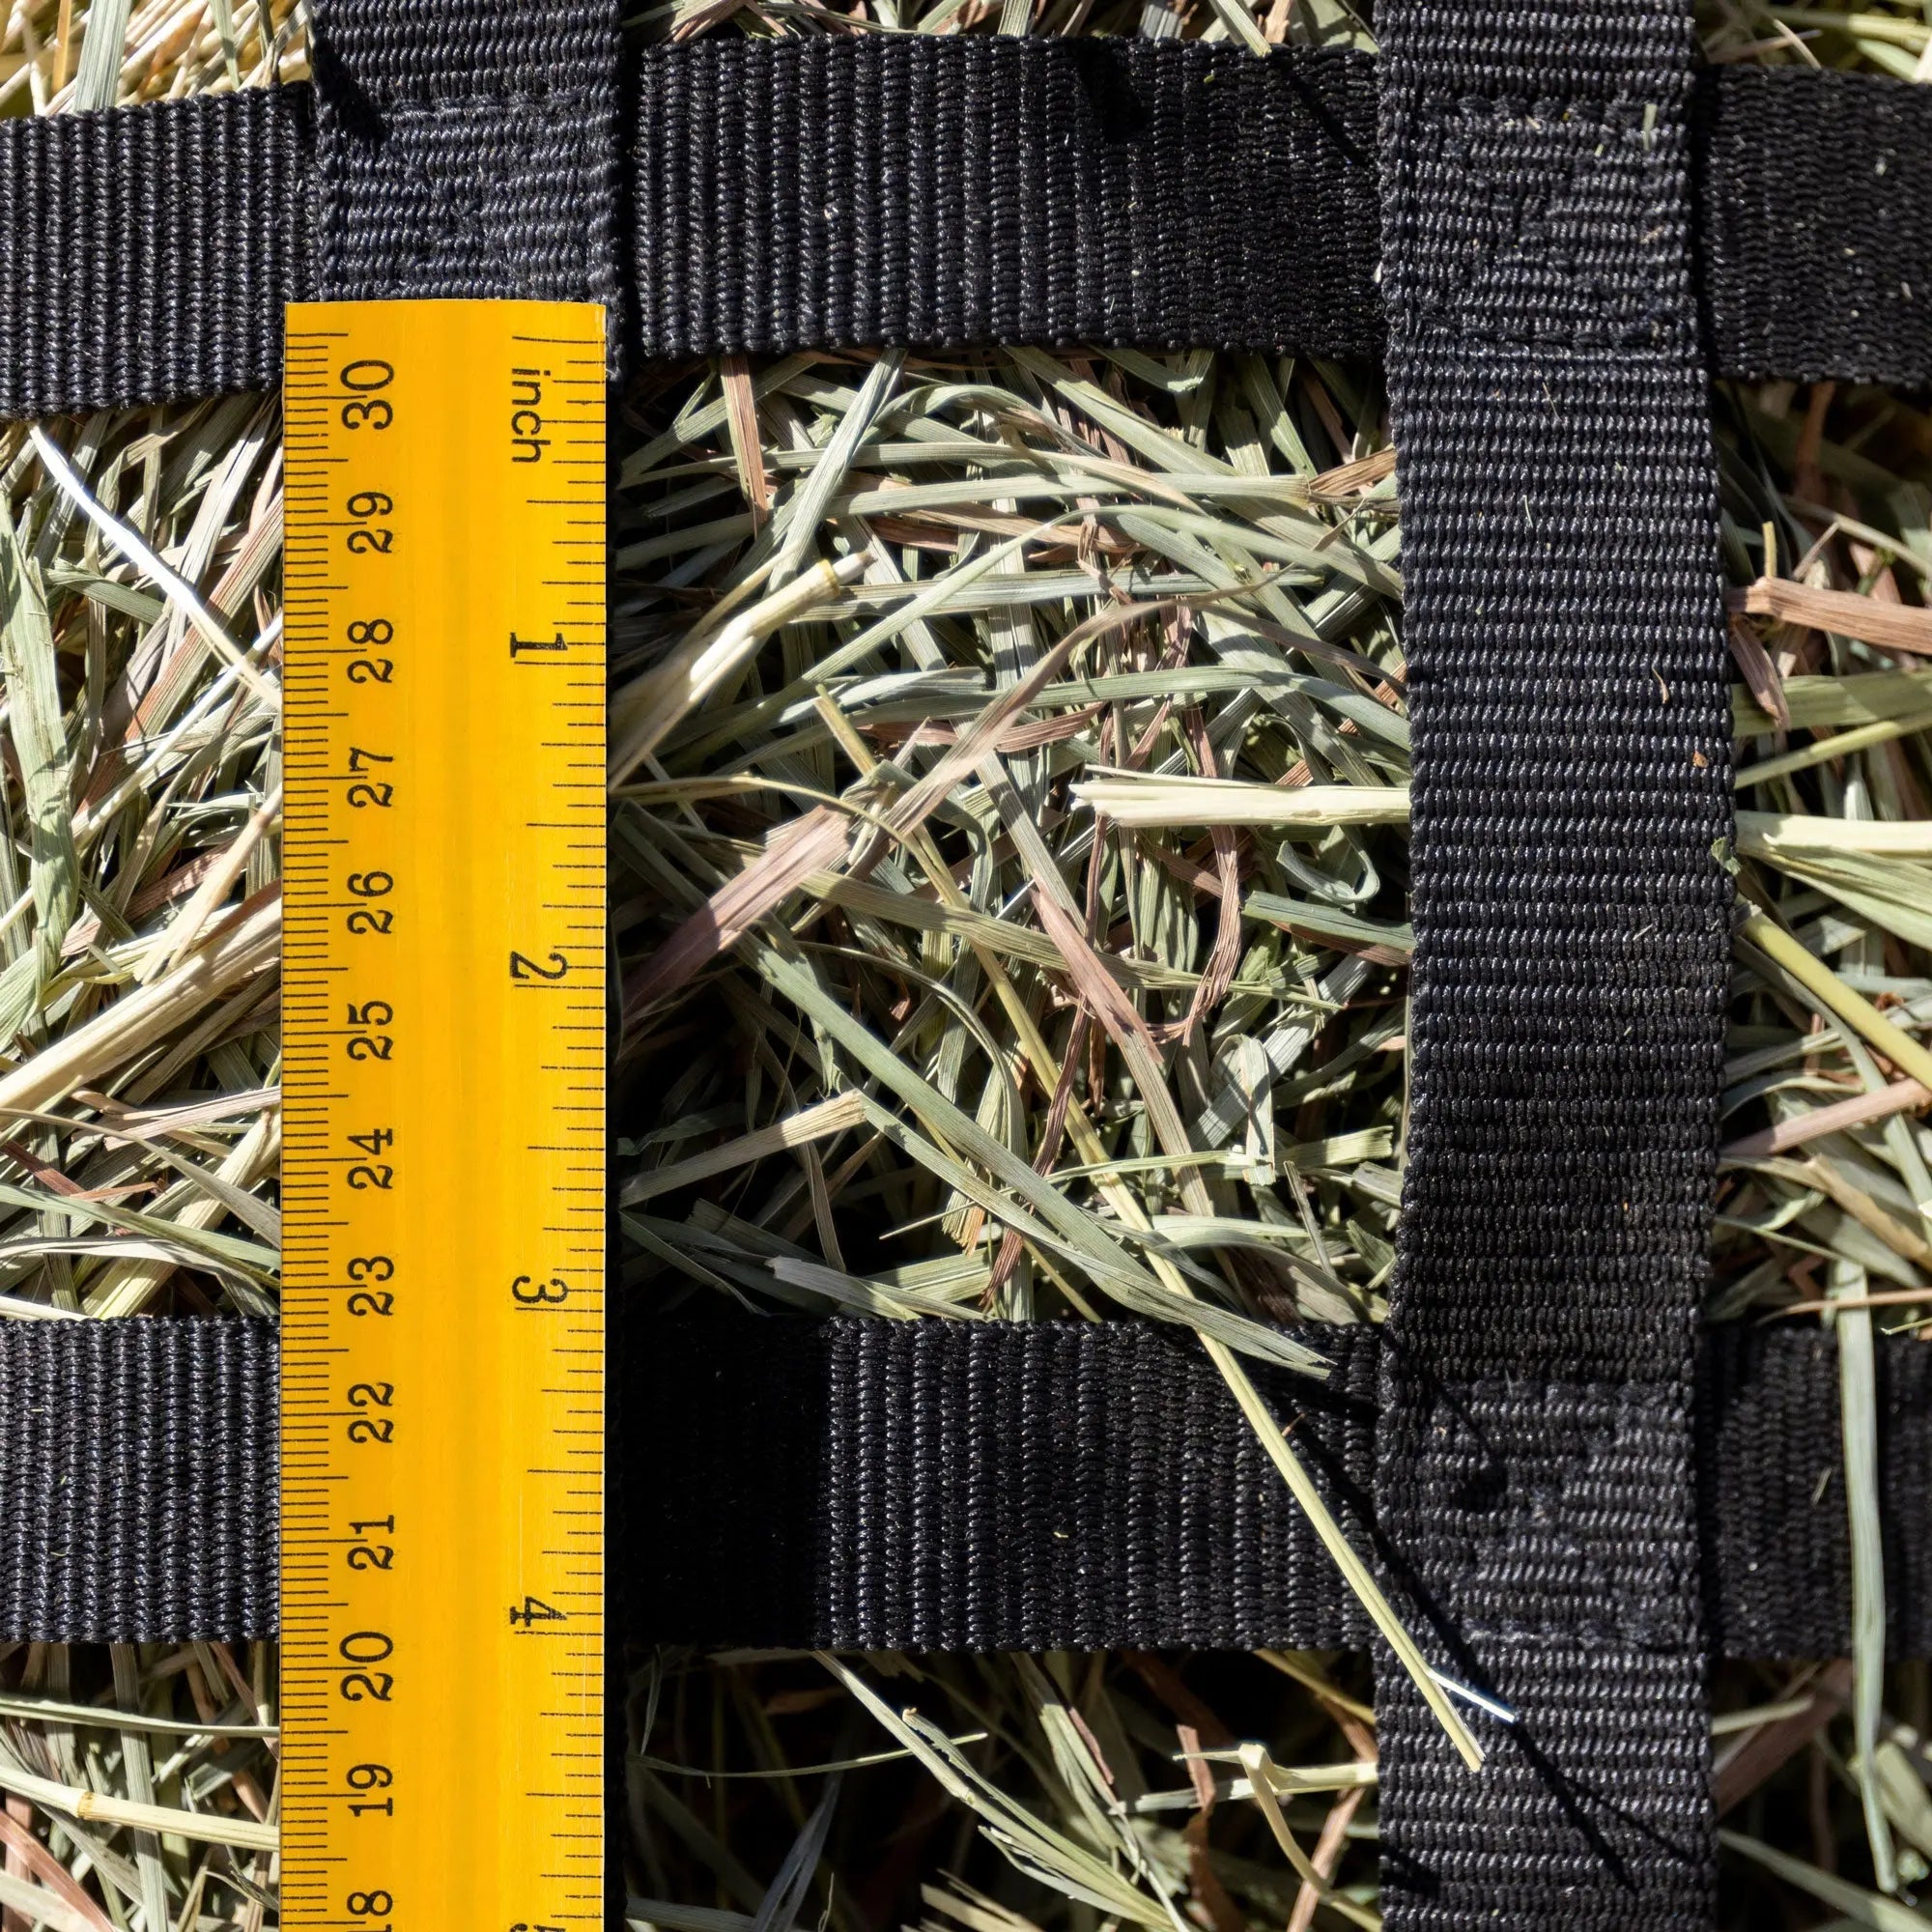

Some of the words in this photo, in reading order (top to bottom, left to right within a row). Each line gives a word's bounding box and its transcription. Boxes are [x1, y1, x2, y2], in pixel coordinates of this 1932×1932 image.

[339, 359, 395, 431] 30
[511, 369, 552, 464] inch
[346, 491, 394, 554] 29
[347, 618, 394, 684] 28
[509, 632, 568, 659] 1
[347, 747, 394, 809] 27
[347, 870, 394, 935] 26
[509, 951, 568, 980] 2
[347, 1000, 394, 1062] 25
[347, 1127, 394, 1190] 24
[347, 1256, 395, 1317] 23
[511, 1275, 568, 1304] 3
[347, 1381, 394, 1444] 22
[347, 1514, 395, 1571] 21
[509, 1596, 568, 1628] 4
[339, 1631, 394, 1702] 20
[346, 1763, 394, 1818] 19
